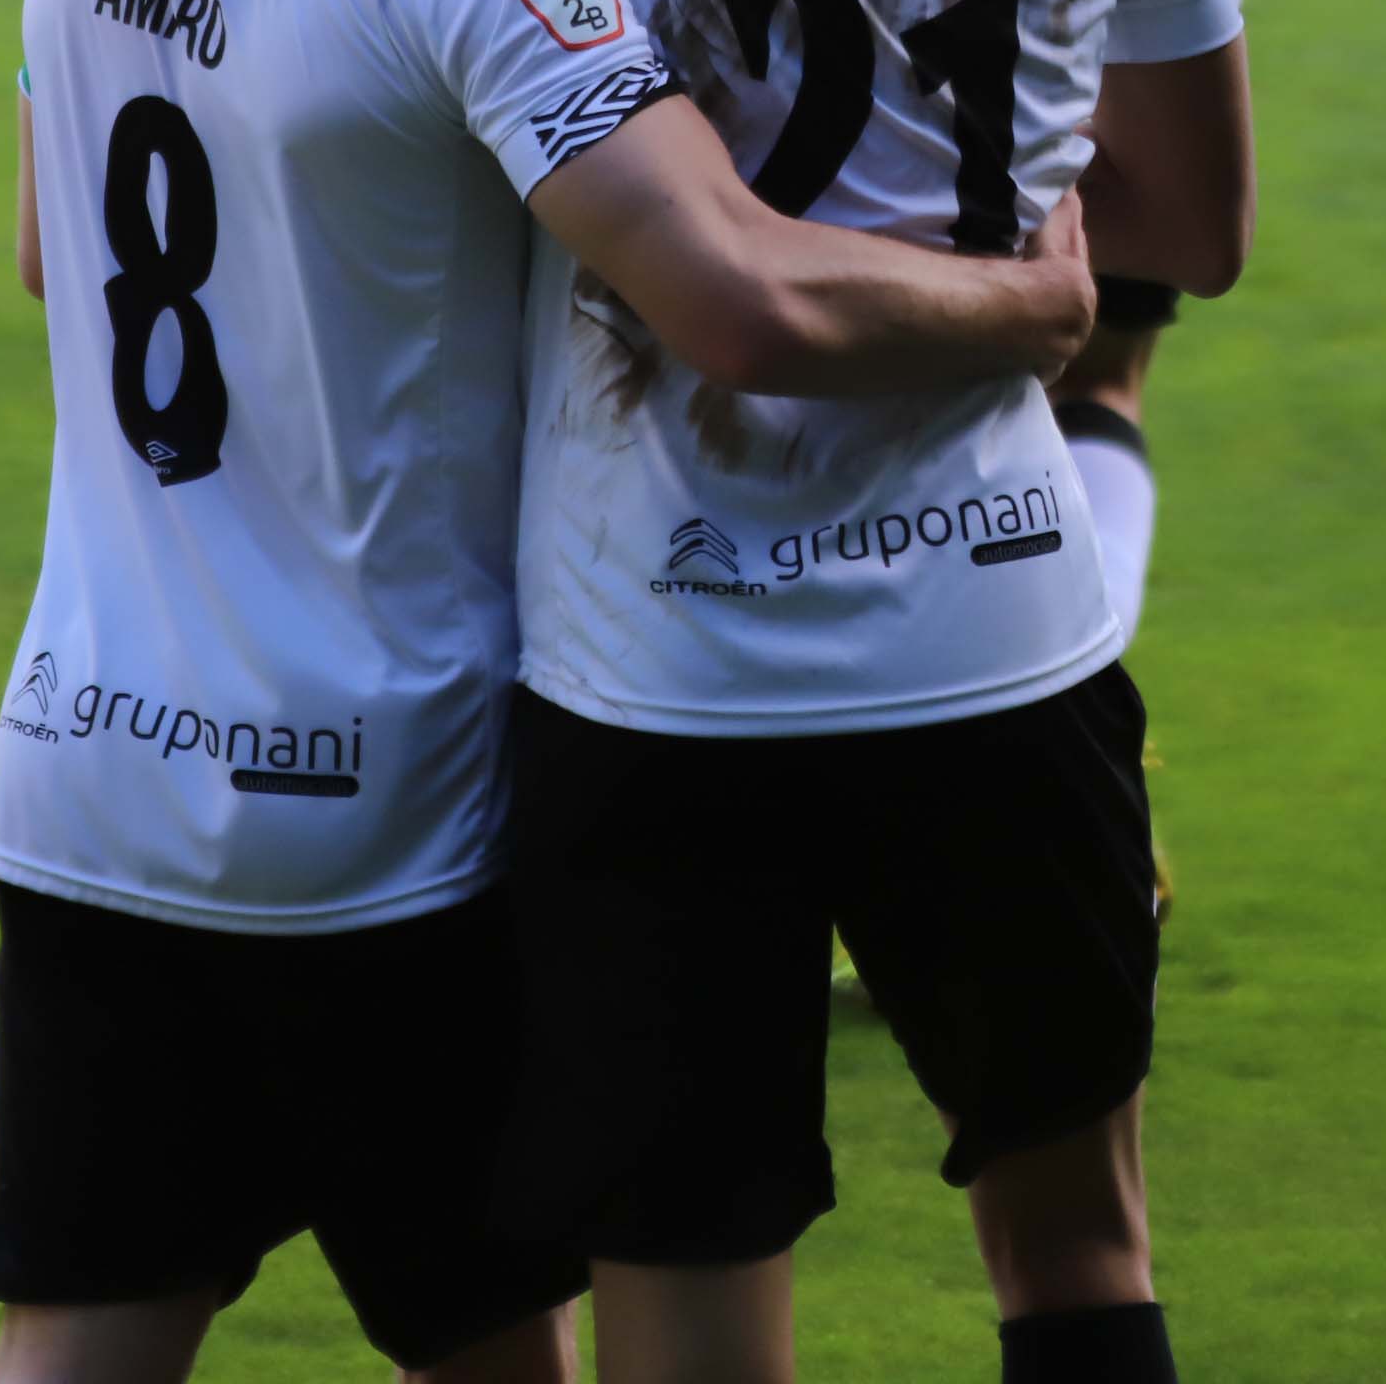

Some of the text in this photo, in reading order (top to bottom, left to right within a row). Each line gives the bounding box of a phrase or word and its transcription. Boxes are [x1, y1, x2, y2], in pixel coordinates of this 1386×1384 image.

[104, 94, 228, 488] 8
[770, 471, 1061, 581] gruponani
[69, 684, 363, 772] gruponani
